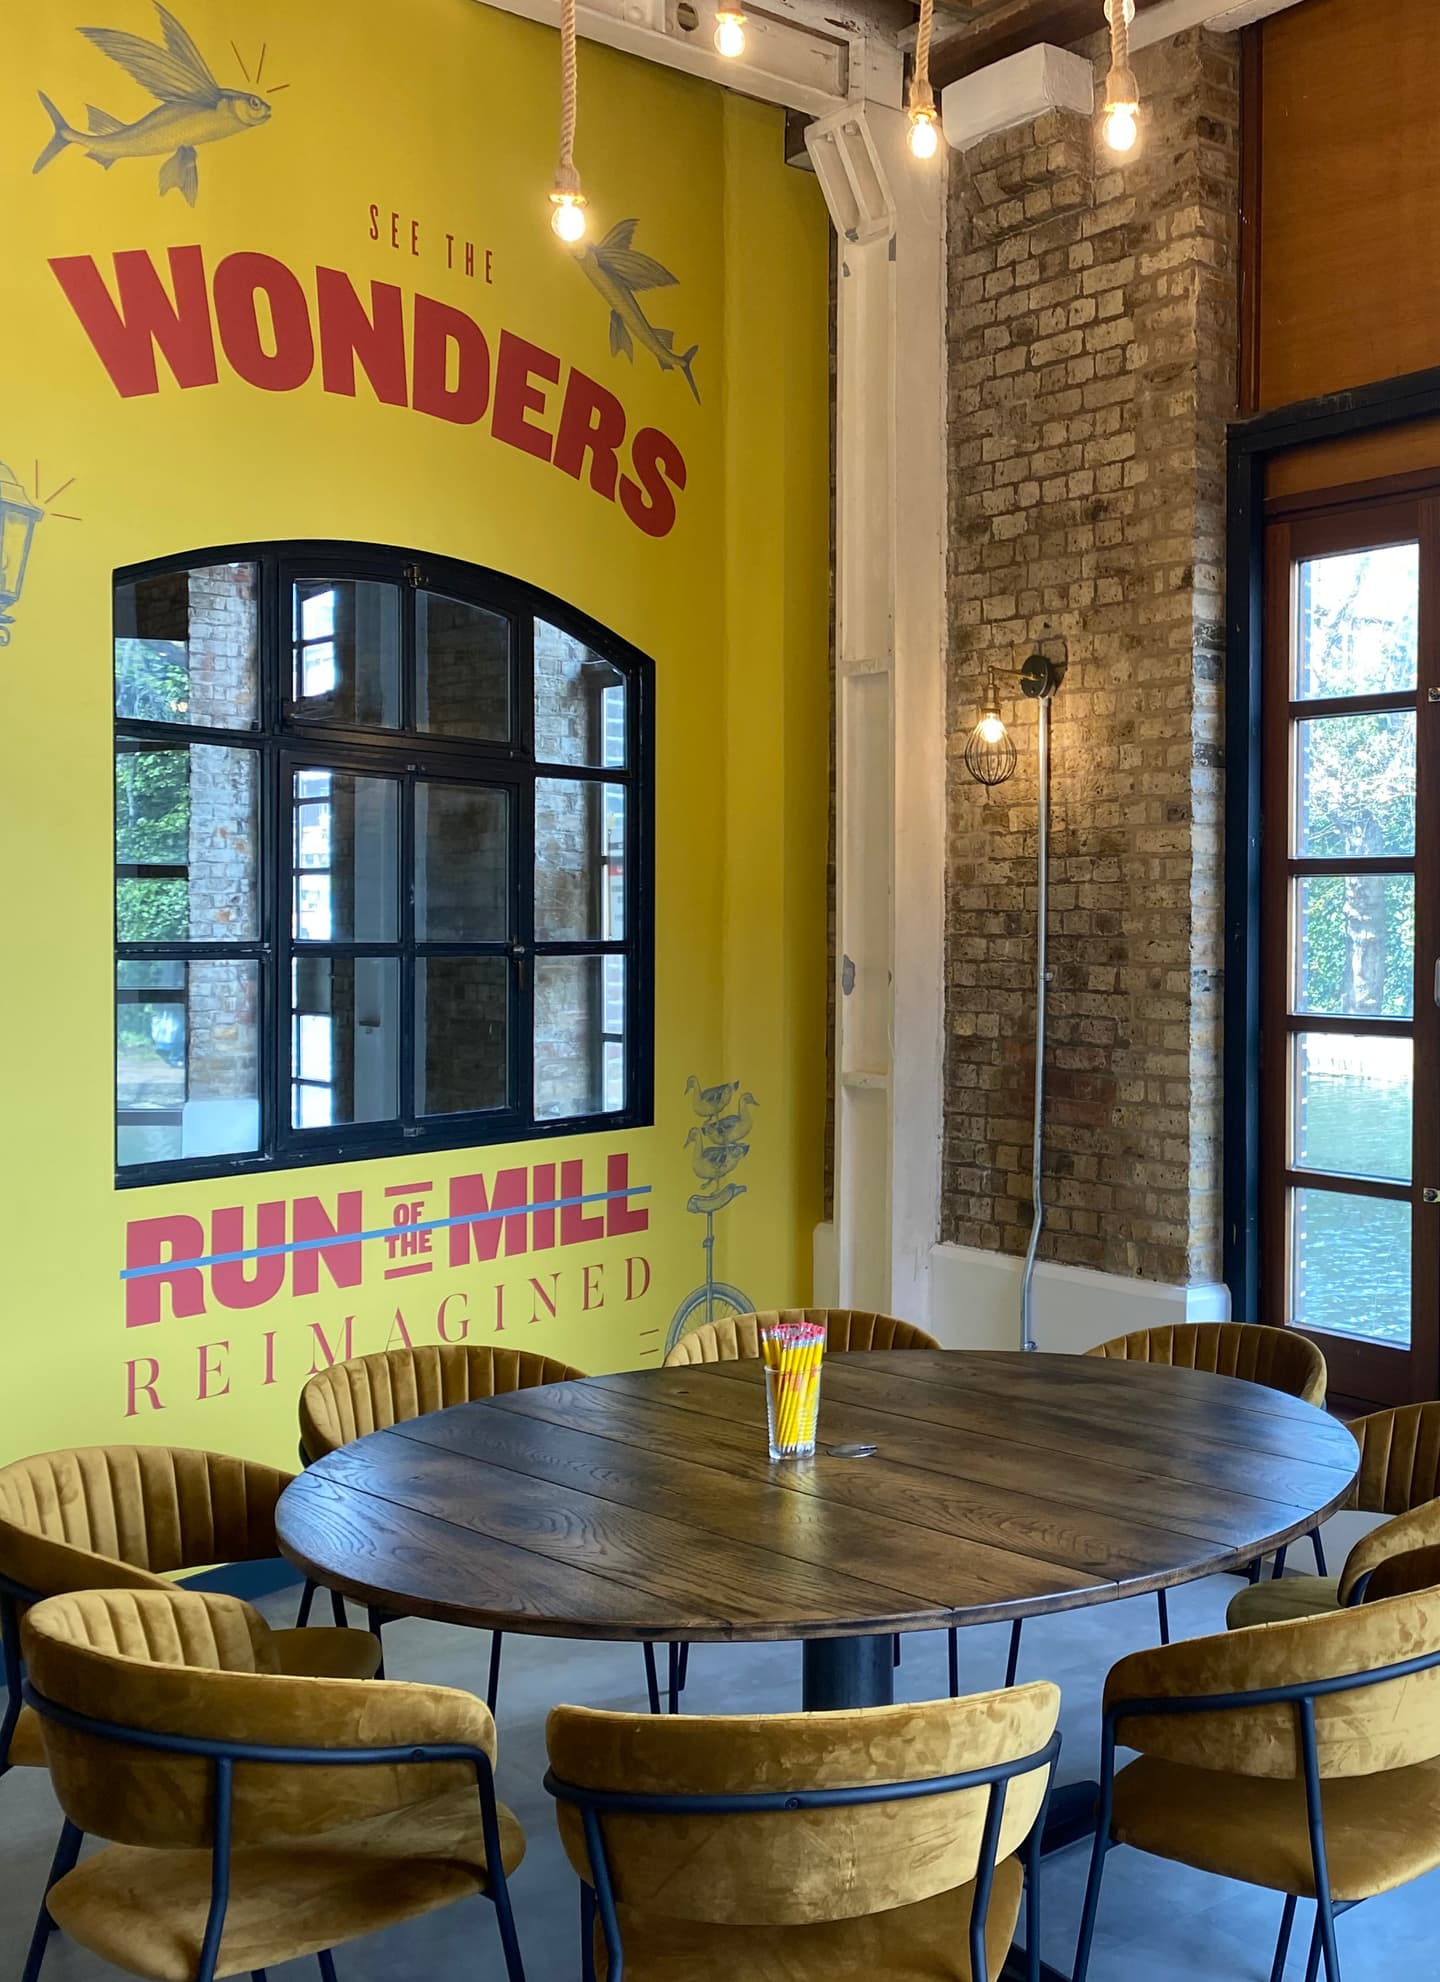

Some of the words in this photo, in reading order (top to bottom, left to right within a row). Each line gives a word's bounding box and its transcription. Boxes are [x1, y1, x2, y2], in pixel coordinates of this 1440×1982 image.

[369, 203, 419, 257] SEE
[445, 233, 493, 285] THE
[47, 244, 687, 538] WONDERS
[126, 1190, 363, 1328] RUN
[383, 1229, 433, 1259] THE
[392, 1200, 425, 1228] OF
[449, 1152, 649, 1268] MILL
[123, 1255, 652, 1418] REIMAGINED
